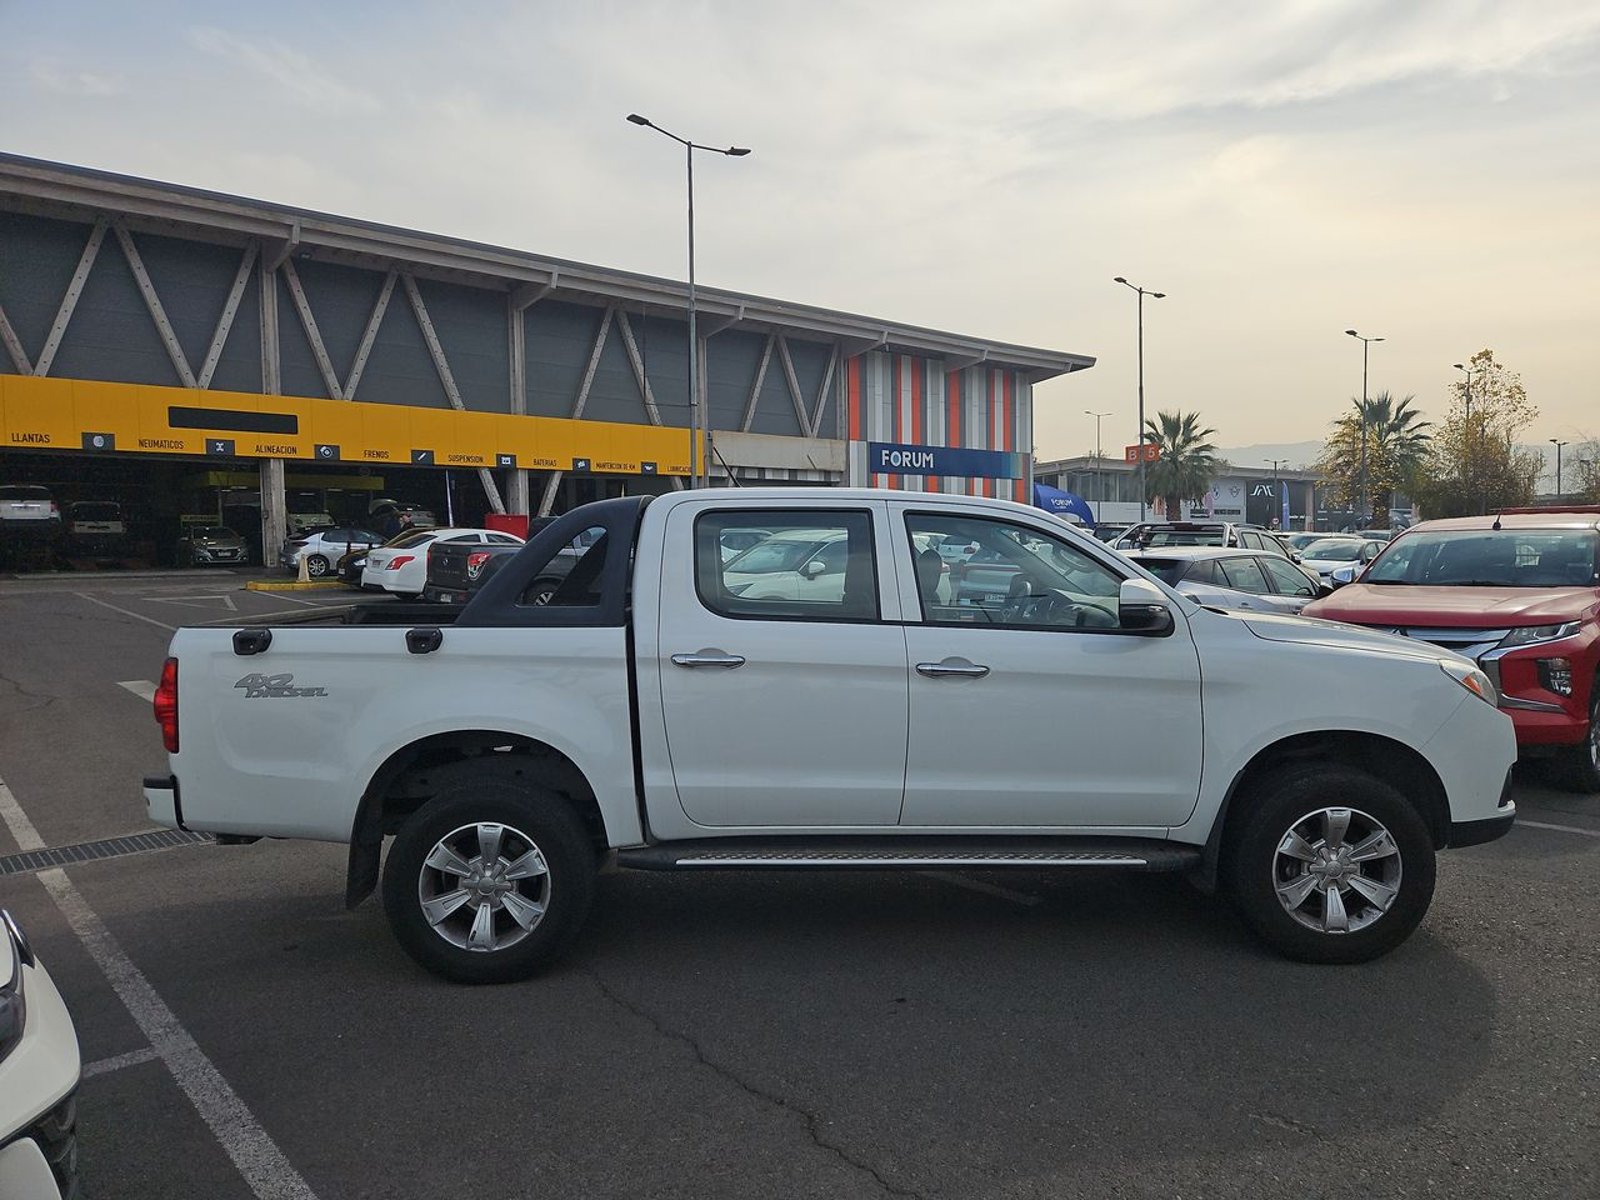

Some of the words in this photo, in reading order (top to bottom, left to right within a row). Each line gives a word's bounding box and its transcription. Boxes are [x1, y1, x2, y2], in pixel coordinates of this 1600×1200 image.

[11, 432, 51, 443] LLANTAS
[138, 439, 185, 450] NEUMATICOS
[255, 445, 297, 455] ALINEACION
[363, 450, 390, 459] FRENOS
[1128, 449, 1138, 461] B
[448, 454, 484, 463] SUSPENSION
[533, 458, 557, 466] BATERIAS
[881, 449, 934, 468] FORUM
